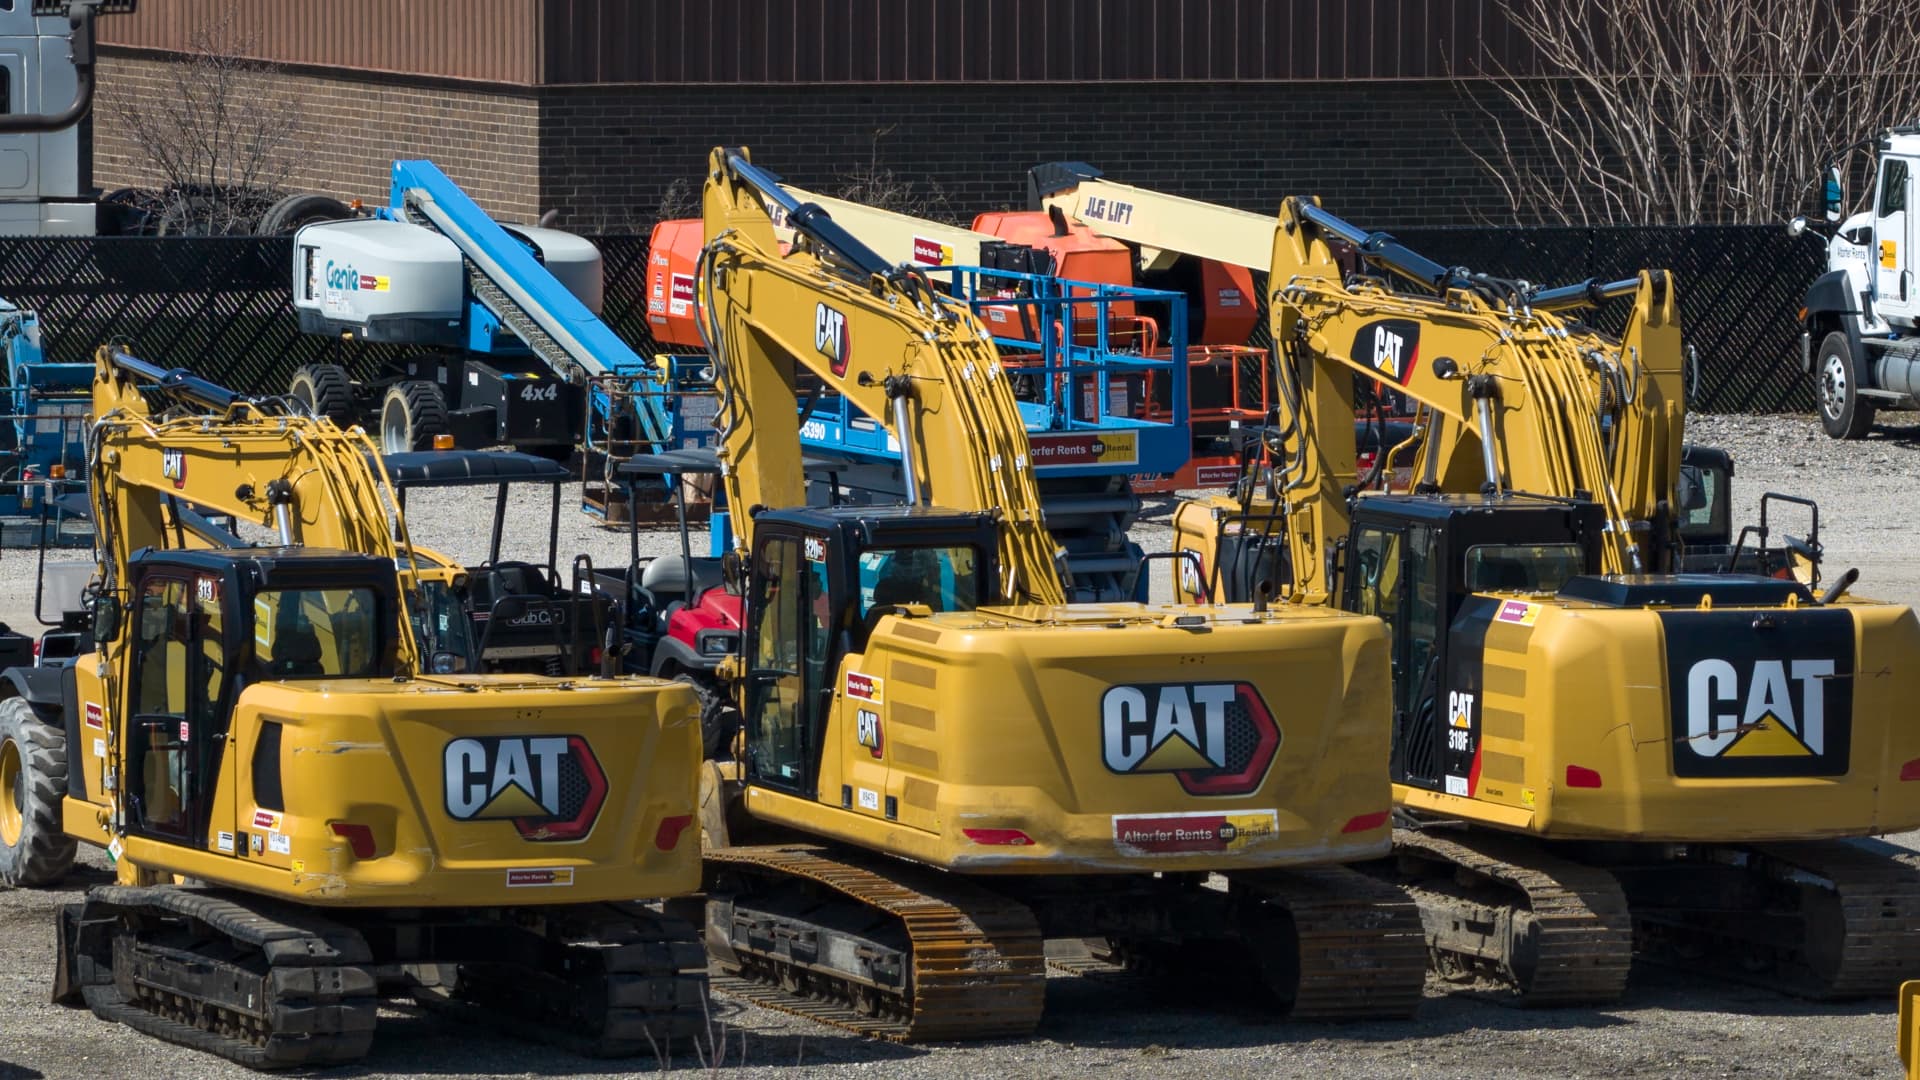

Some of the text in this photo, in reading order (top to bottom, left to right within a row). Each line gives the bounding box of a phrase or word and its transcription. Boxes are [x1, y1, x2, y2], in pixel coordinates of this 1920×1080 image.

[1084, 196, 1134, 225] JLG LIFT
[326, 259, 359, 290] Genie
[815, 303, 843, 360] CAT
[1374, 326, 1403, 378] CAT
[521, 384, 557, 400] 4x4
[164, 448, 182, 480] CAT
[1031, 446, 1055, 456] orfer
[1057, 445, 1086, 455] Rents
[198, 579, 212, 600] 313
[1449, 691, 1473, 728] CAT
[1688, 659, 1835, 757] CAT
[858, 709, 877, 748] CAT
[1103, 685, 1235, 771] CAT
[1449, 729, 1468, 751] 318F
[446, 738, 568, 818] CAT
[1123, 830, 1172, 843] Altorfer
[1175, 829, 1212, 840] Rents
